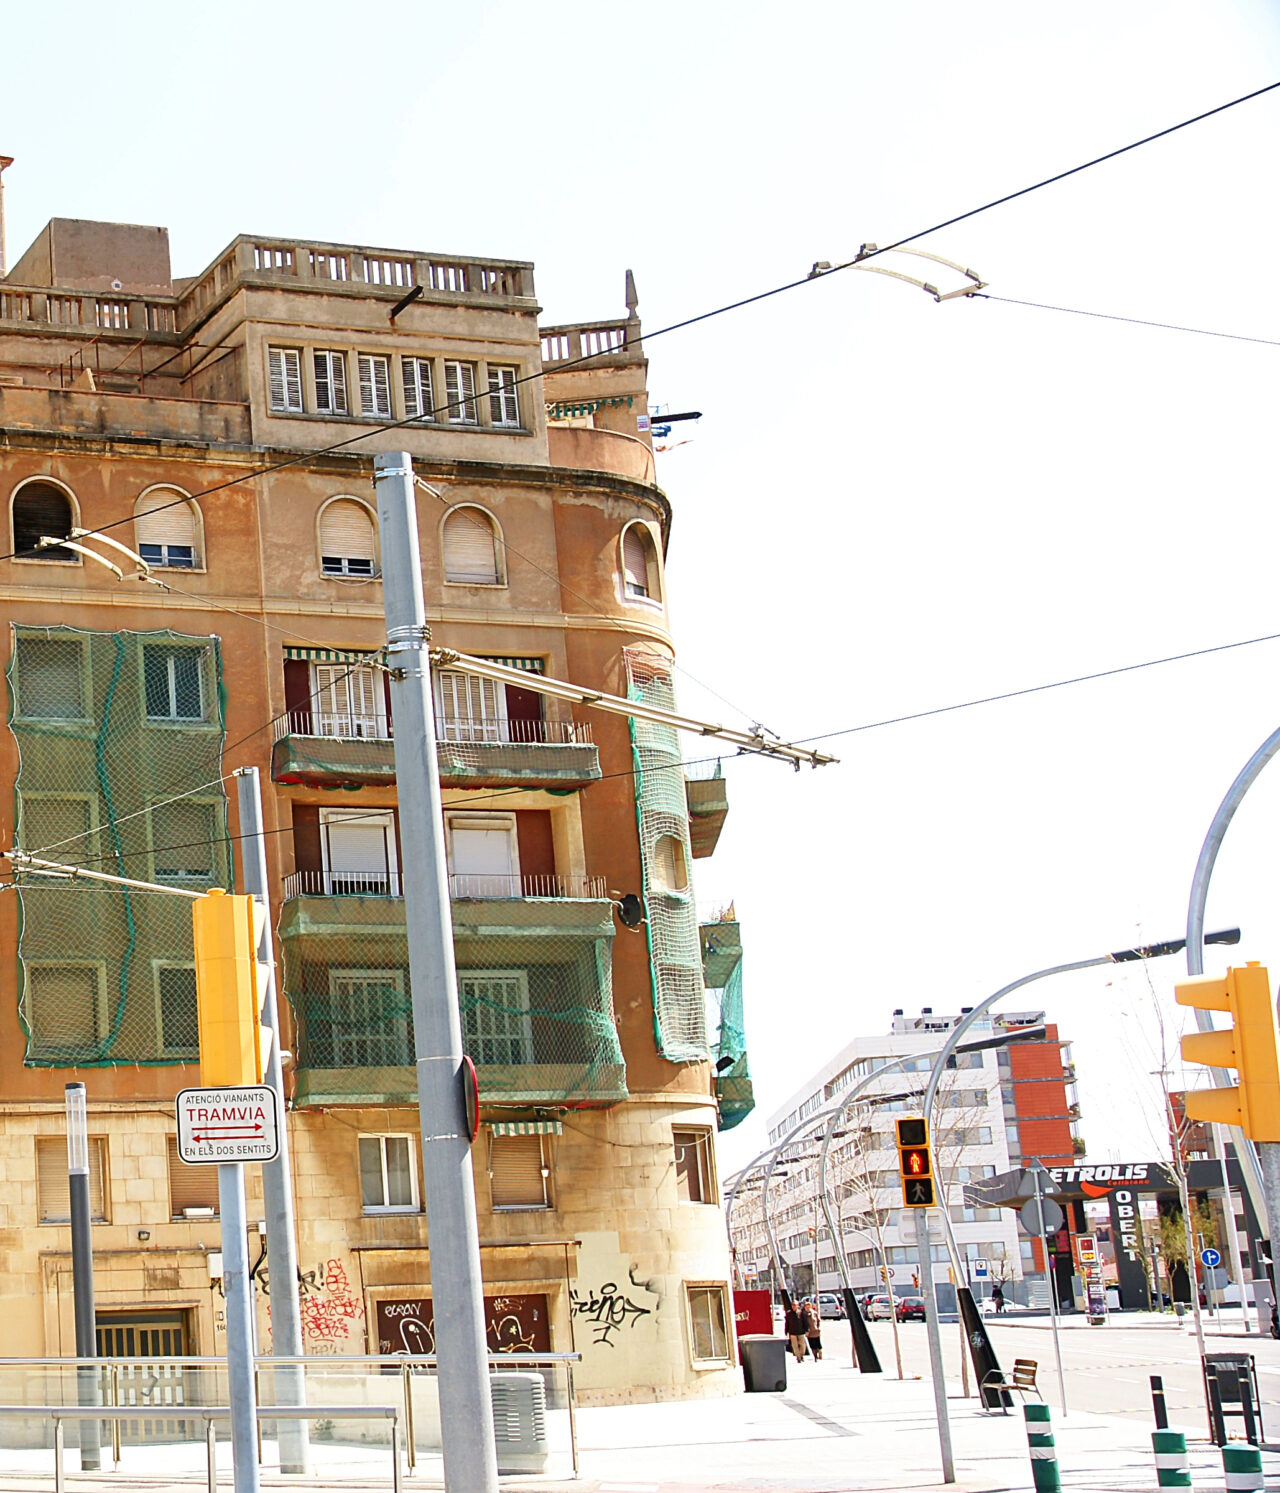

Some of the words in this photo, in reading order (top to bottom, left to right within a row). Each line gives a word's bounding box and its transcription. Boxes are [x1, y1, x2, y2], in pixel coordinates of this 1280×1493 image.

[186, 1094, 221, 1104] ATENCIÓ
[224, 1093, 265, 1103] VIANANTS
[186, 1107, 266, 1122] TRAMVIA
[185, 1147, 196, 1156] EN
[198, 1146, 214, 1156] ELS
[217, 1146, 234, 1155] DOS
[237, 1144, 272, 1155] SENTITS
[1050, 1165, 1148, 1182] ETROLIS
[1115, 1190, 1140, 1261] OBERT
